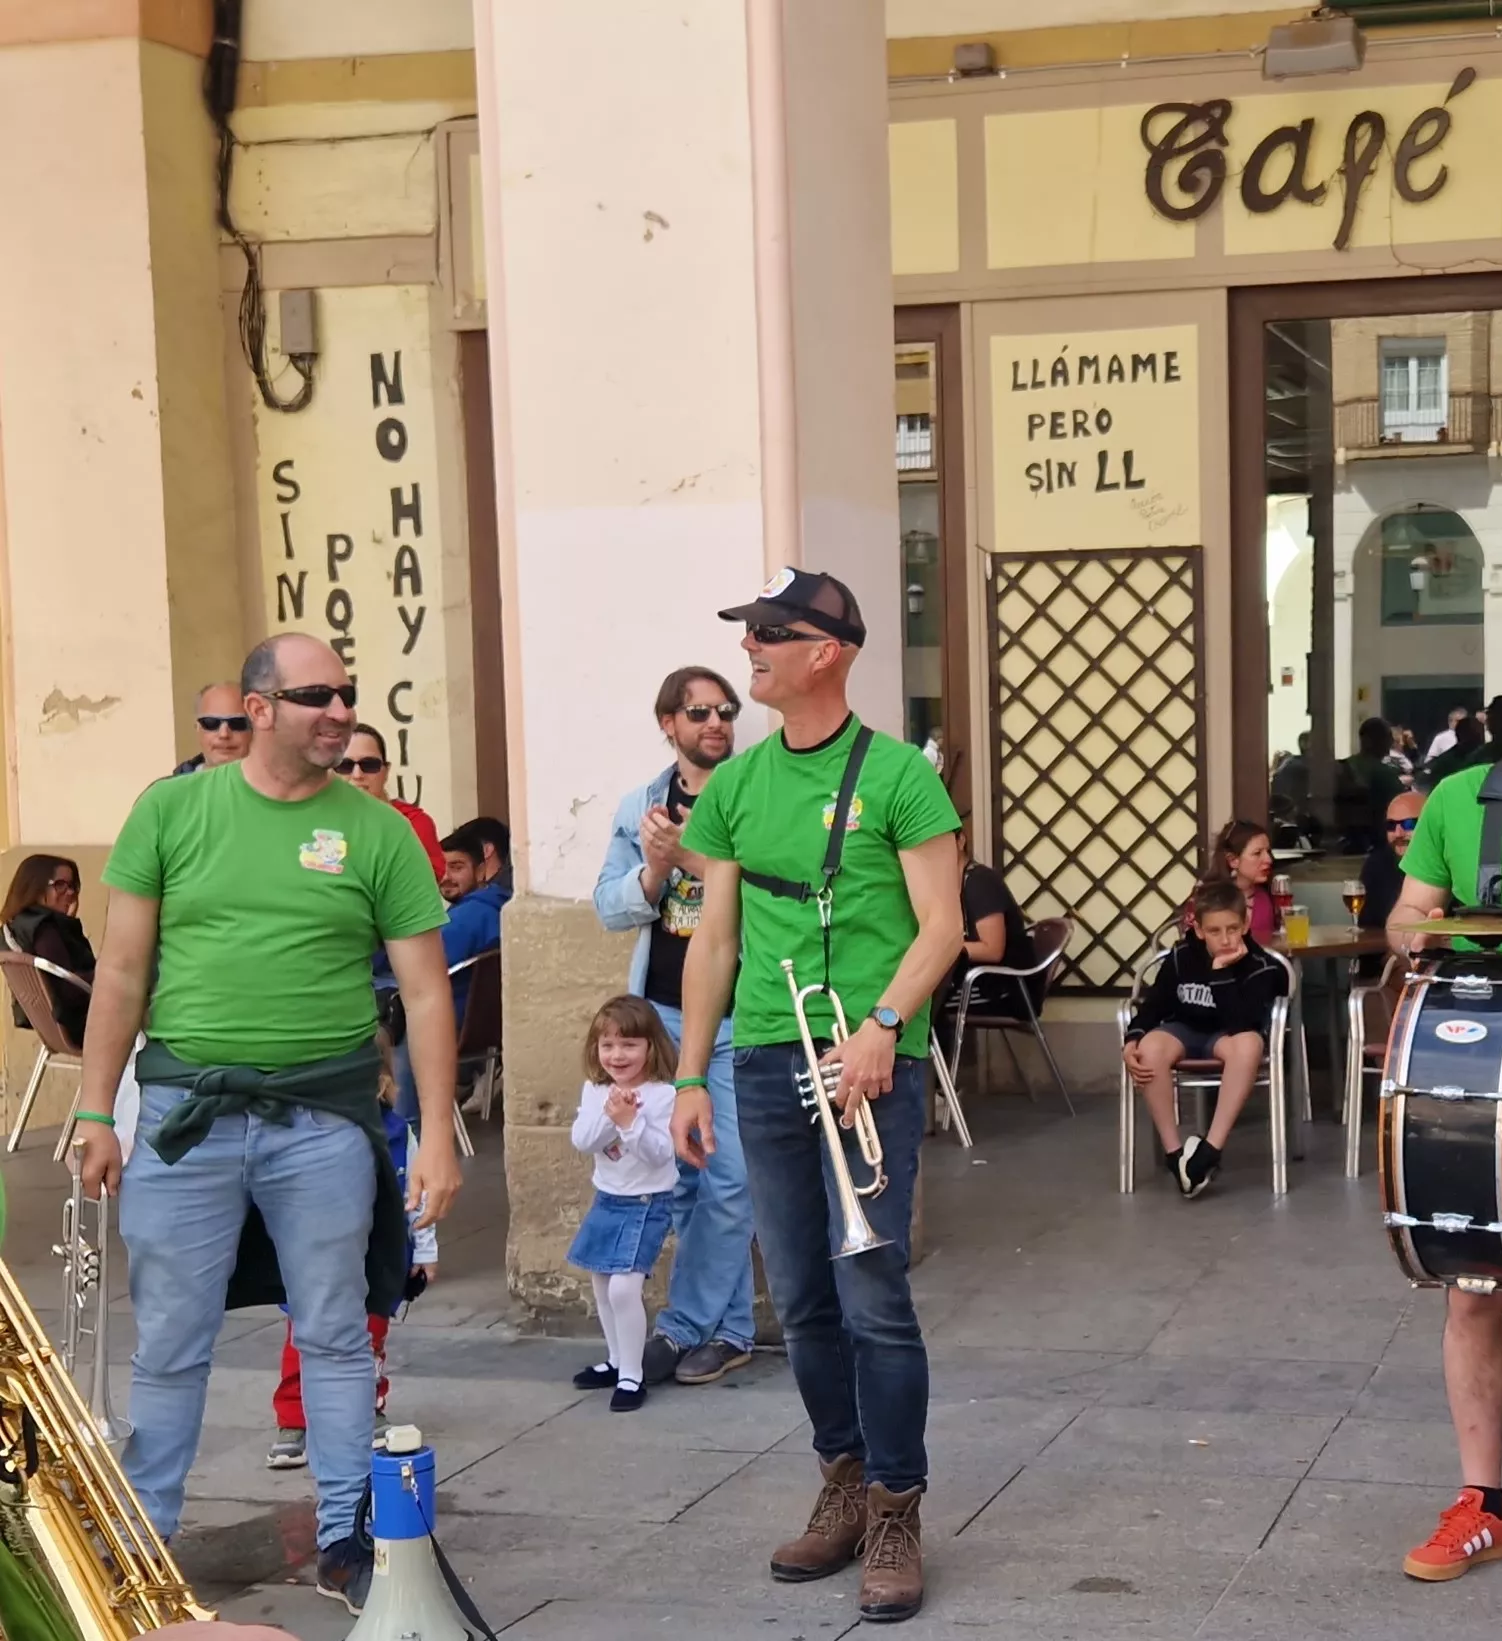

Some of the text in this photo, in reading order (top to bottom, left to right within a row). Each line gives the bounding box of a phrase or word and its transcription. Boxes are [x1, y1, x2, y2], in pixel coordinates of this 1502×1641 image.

[1140, 66, 1477, 251] Café
[1012, 344, 1181, 392] LLÁMAME
[1025, 449, 1145, 495] SIN LL
[1027, 407, 1112, 441] PERO
[272, 459, 308, 623] SIN
[370, 350, 408, 463] NO
[390, 482, 426, 655] HAY
